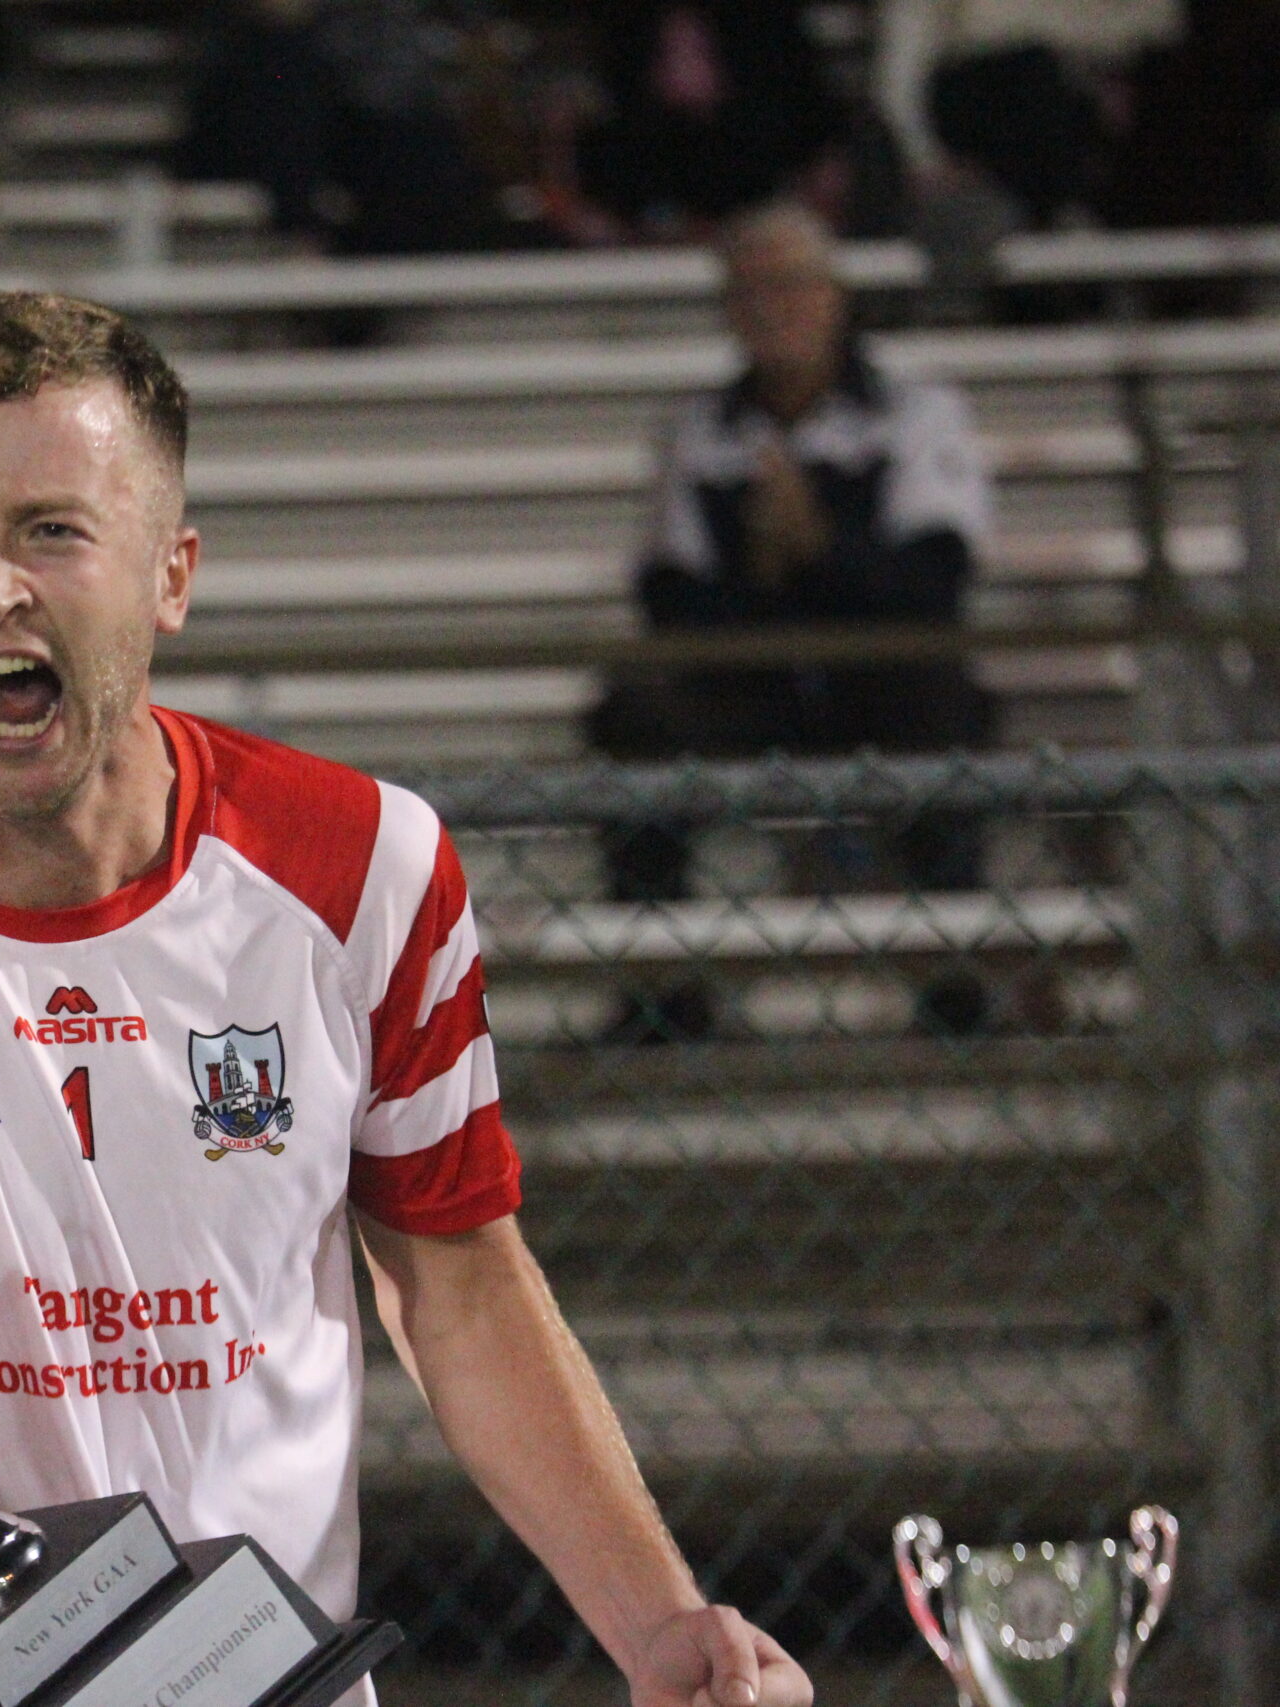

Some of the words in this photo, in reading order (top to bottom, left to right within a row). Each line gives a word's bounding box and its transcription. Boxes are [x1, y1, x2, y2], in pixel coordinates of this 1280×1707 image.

[61, 1066, 95, 1161] 1
[220, 1135, 253, 1149] CORK
[254, 1132, 270, 1147] NY
[224, 1329, 266, 1385] In.
[13, 1628, 51, 1660] New
[50, 1592, 96, 1631] York
[93, 1552, 140, 1595] GAA
[154, 1598, 280, 1707] Championship
